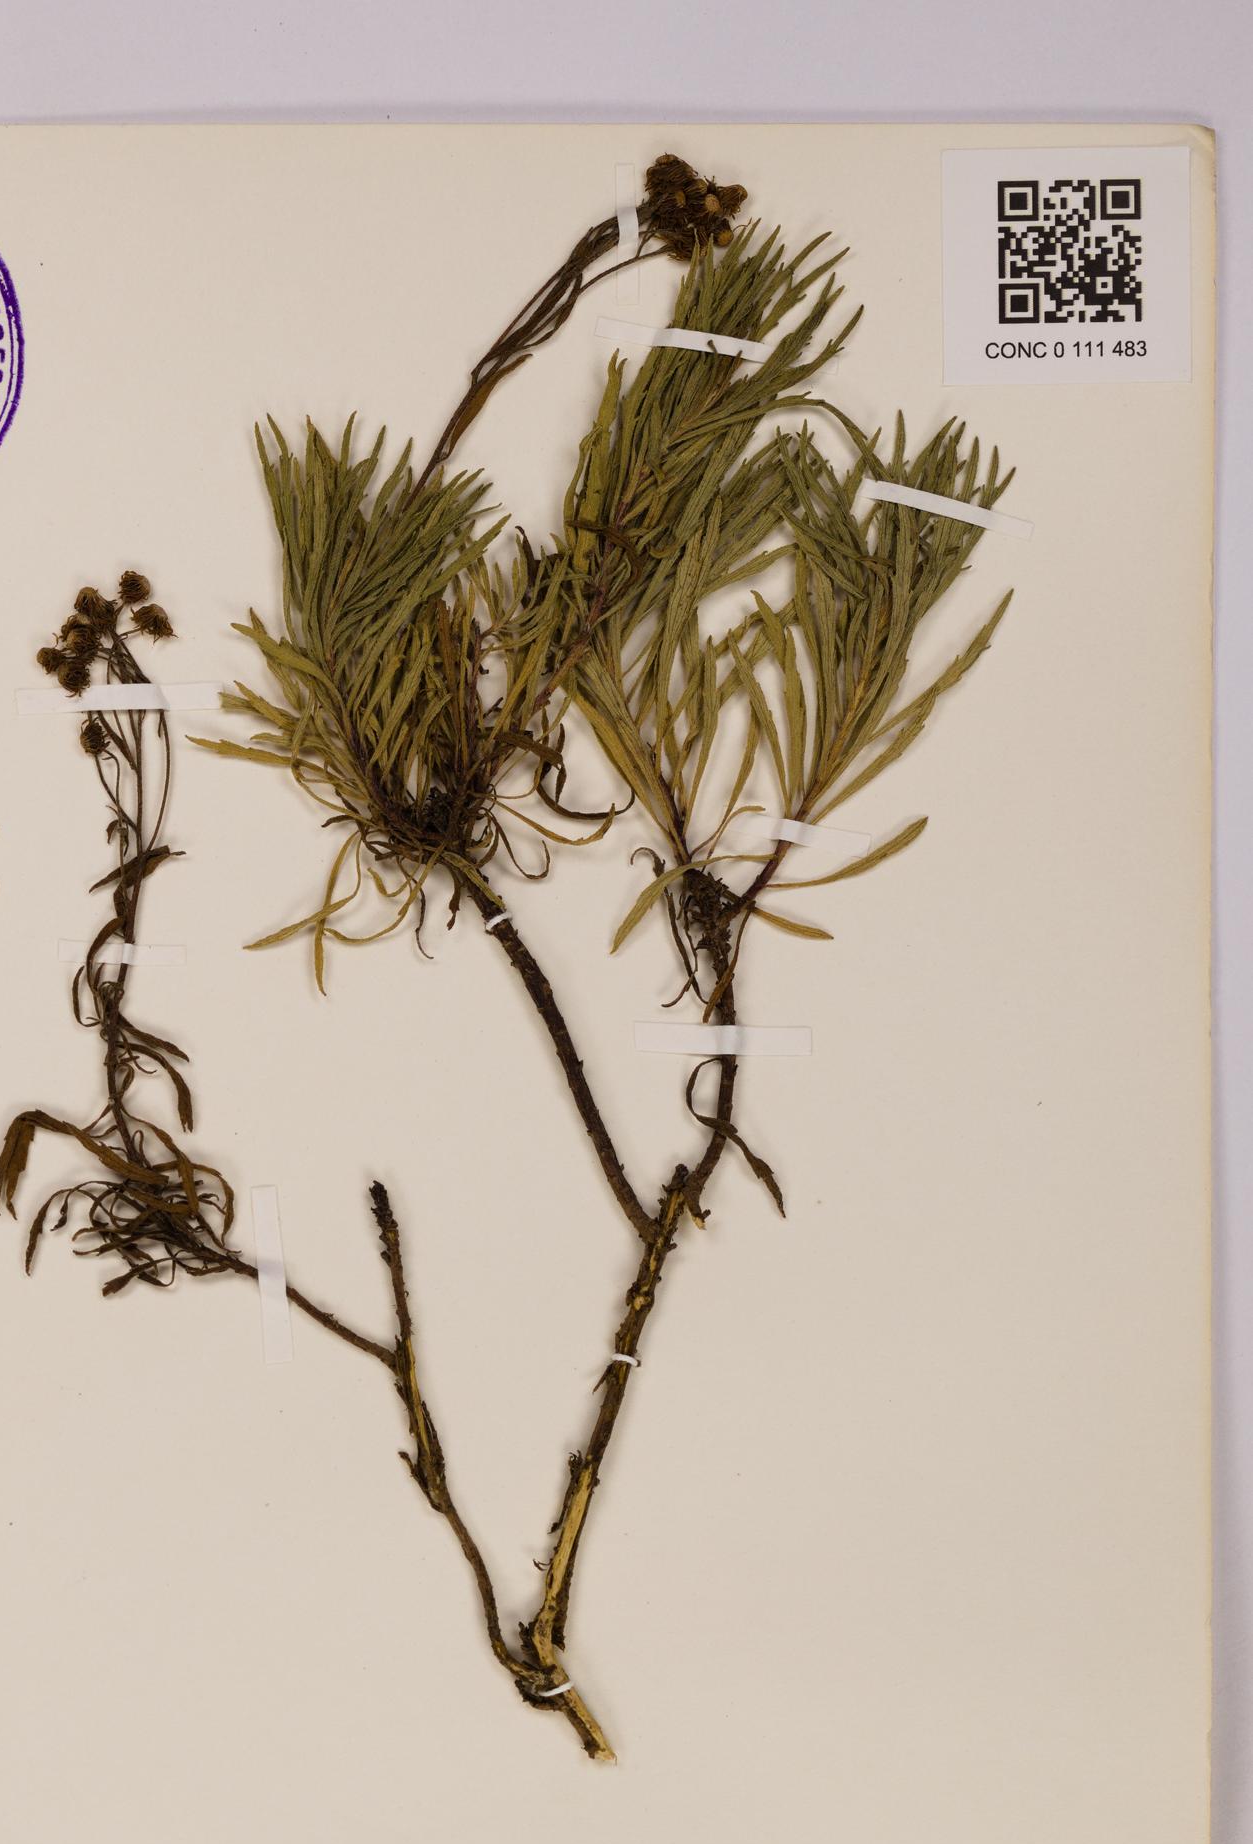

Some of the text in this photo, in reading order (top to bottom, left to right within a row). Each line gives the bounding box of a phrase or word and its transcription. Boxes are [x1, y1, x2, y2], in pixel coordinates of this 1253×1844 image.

[985, 340, 1148, 360] CONC 0 111 483
